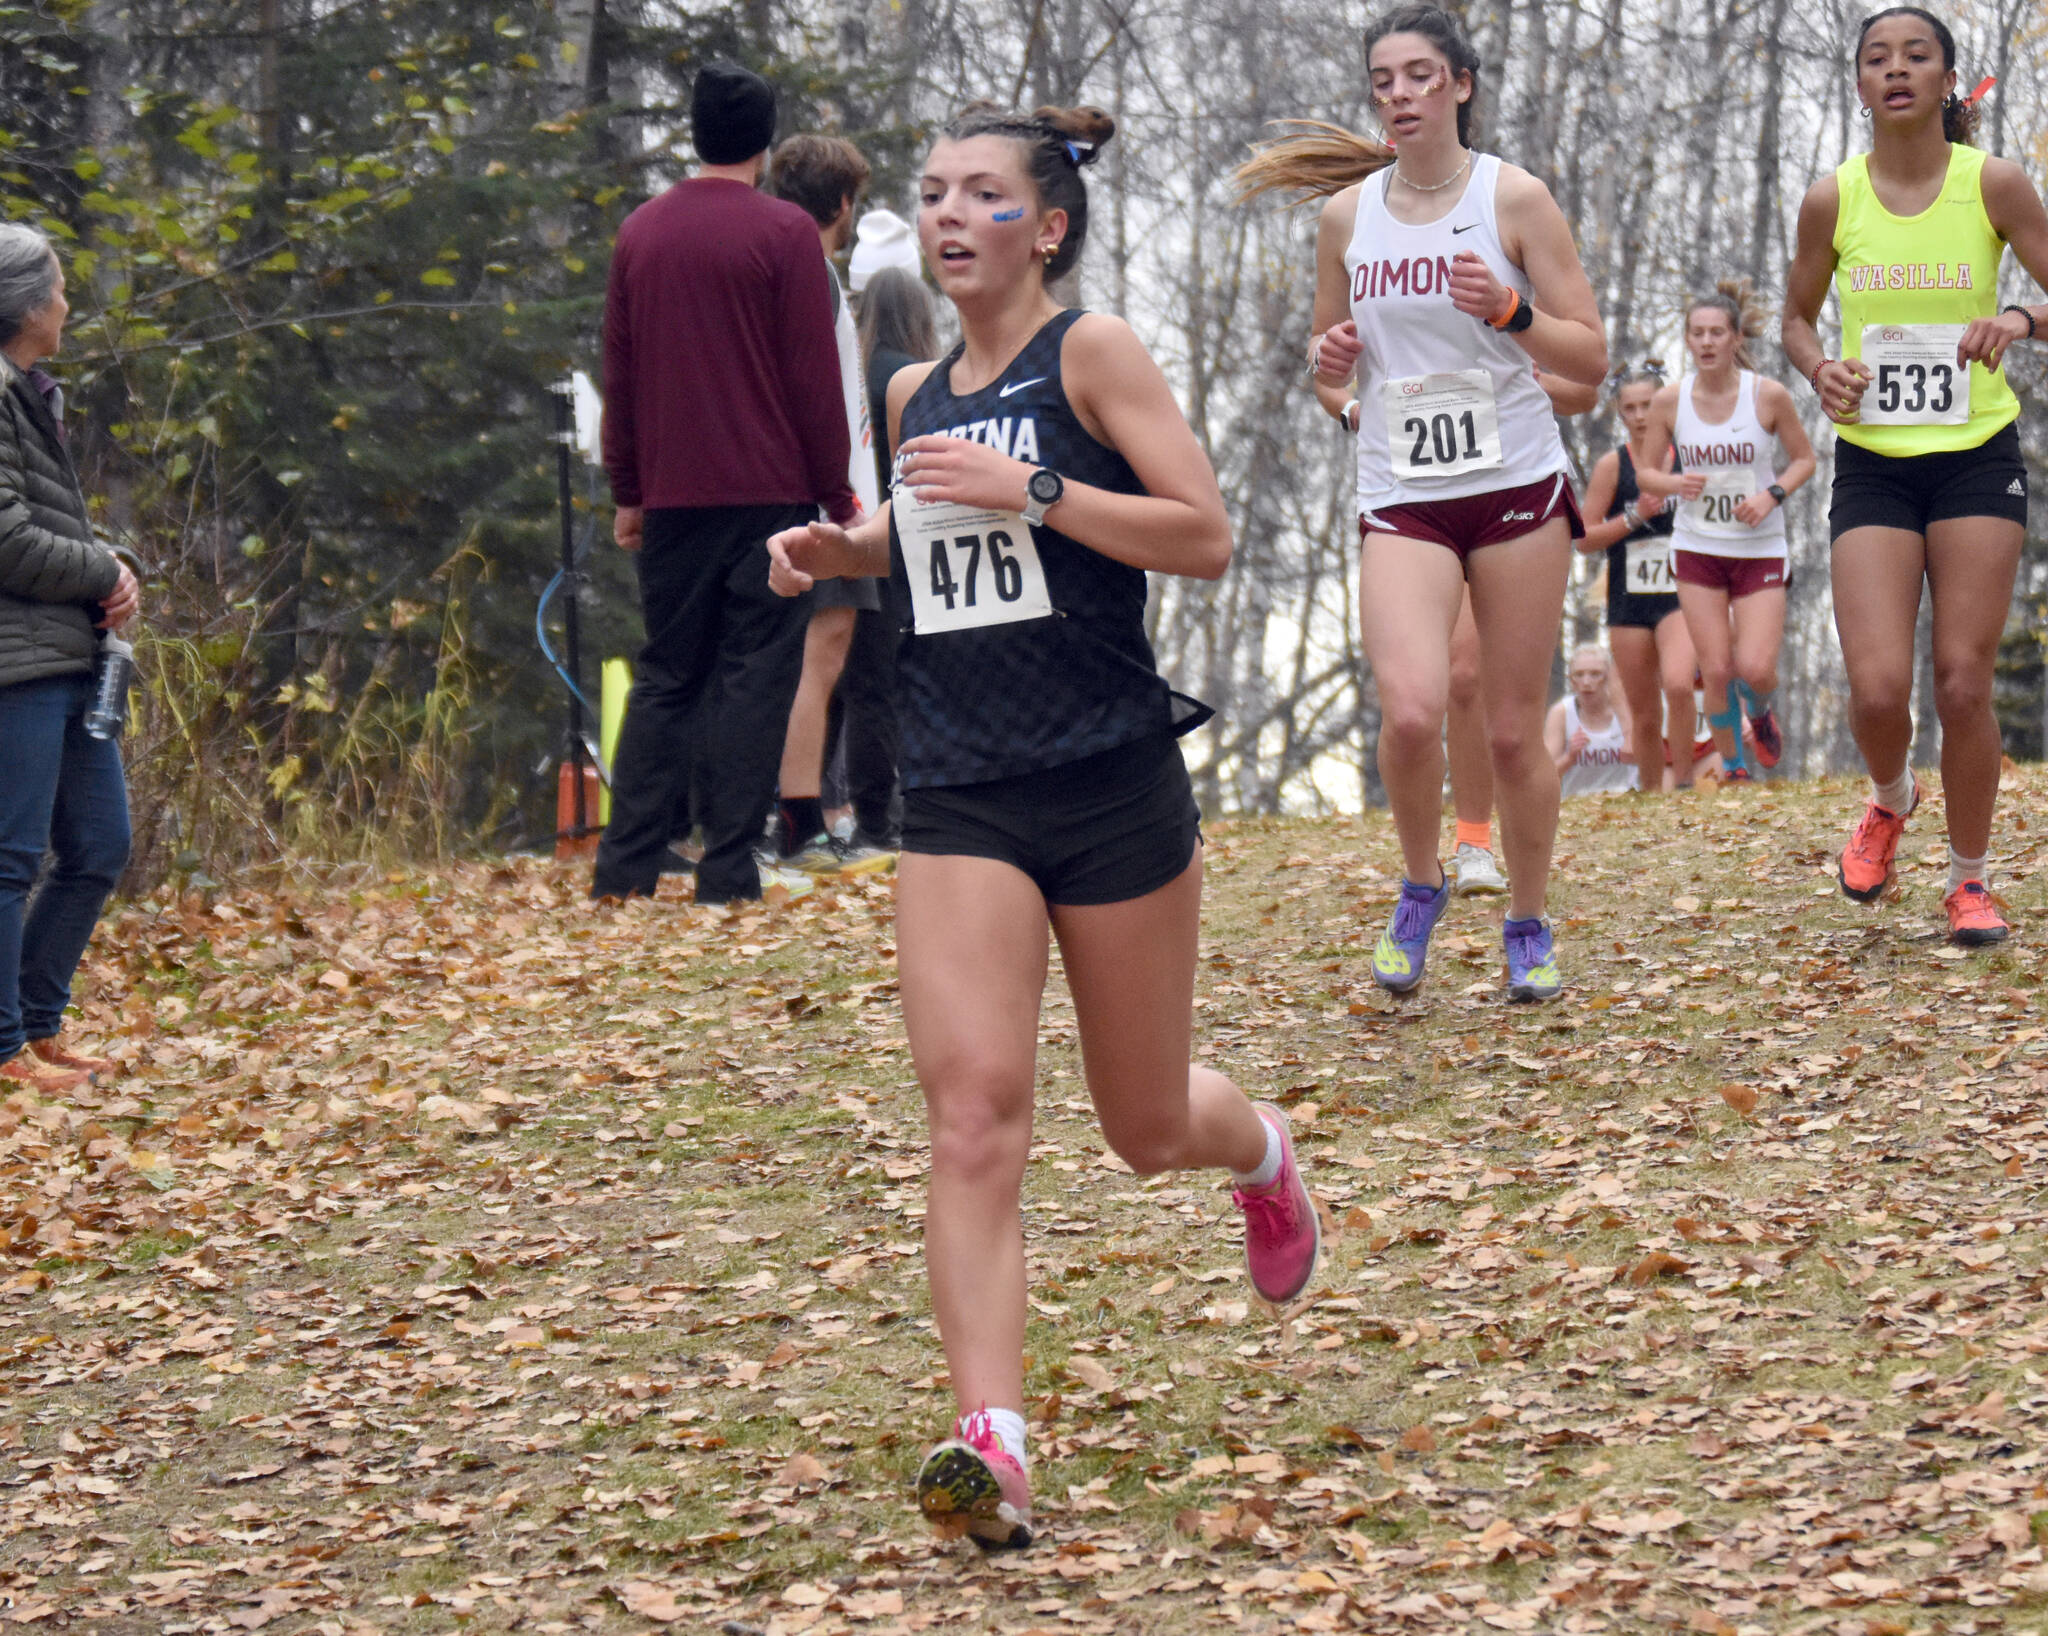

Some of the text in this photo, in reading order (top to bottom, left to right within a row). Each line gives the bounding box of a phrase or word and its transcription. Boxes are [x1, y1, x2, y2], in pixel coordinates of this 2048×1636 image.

[1353, 254, 1458, 302] DIMON
[1850, 263, 1973, 292] WASILLA
[1882, 331, 1903, 341] GCI
[1402, 383, 1423, 395] GCI
[1878, 364, 1953, 412] 533
[1404, 410, 1483, 467] 201
[1680, 442, 1755, 467] DIMOND
[930, 530, 1022, 610] 476
